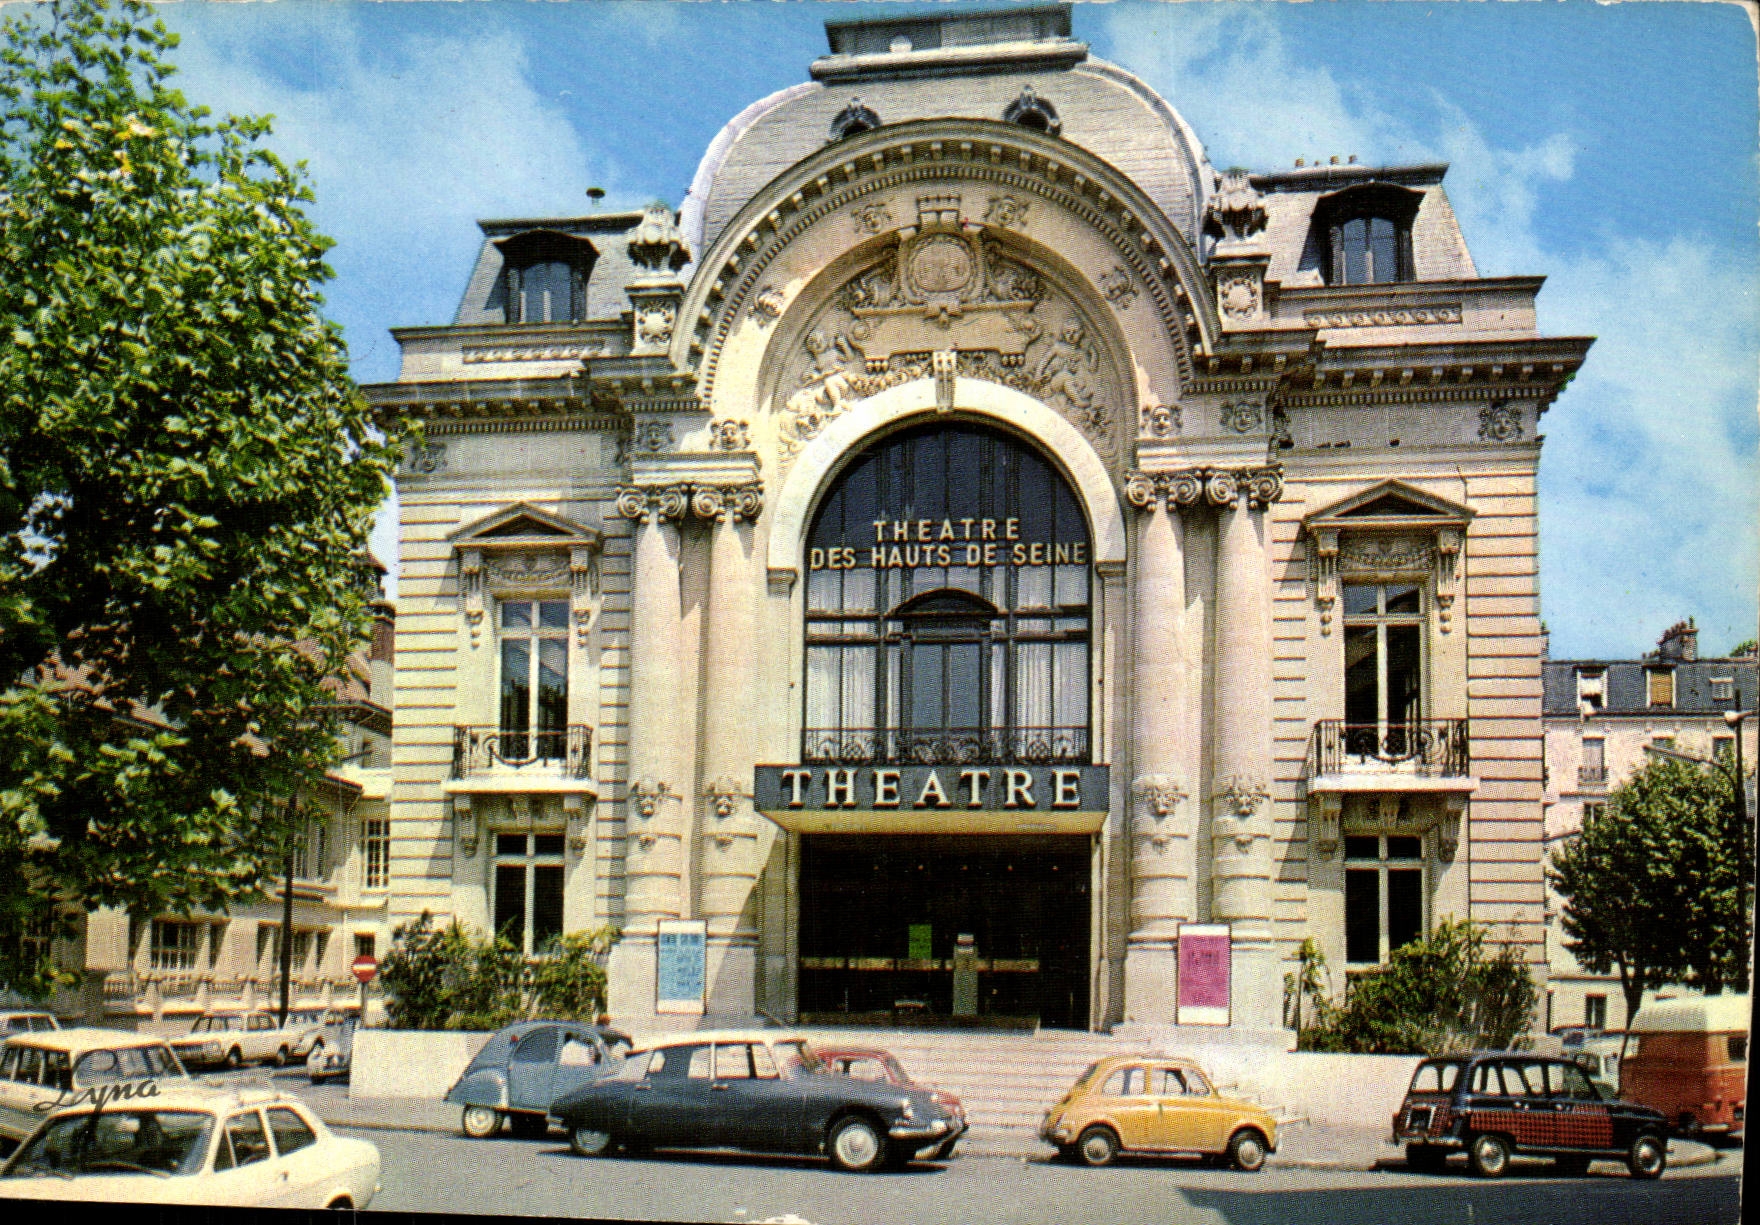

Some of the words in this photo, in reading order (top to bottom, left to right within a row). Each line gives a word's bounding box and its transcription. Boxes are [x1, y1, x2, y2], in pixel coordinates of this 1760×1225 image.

[873, 518, 1020, 542] THEATRE
[810, 547, 857, 570] DES
[871, 545, 951, 569] HAUTS
[966, 544, 998, 567] DE
[1012, 542, 1087, 566] SEINE
[782, 768, 1081, 808] THEATRE
